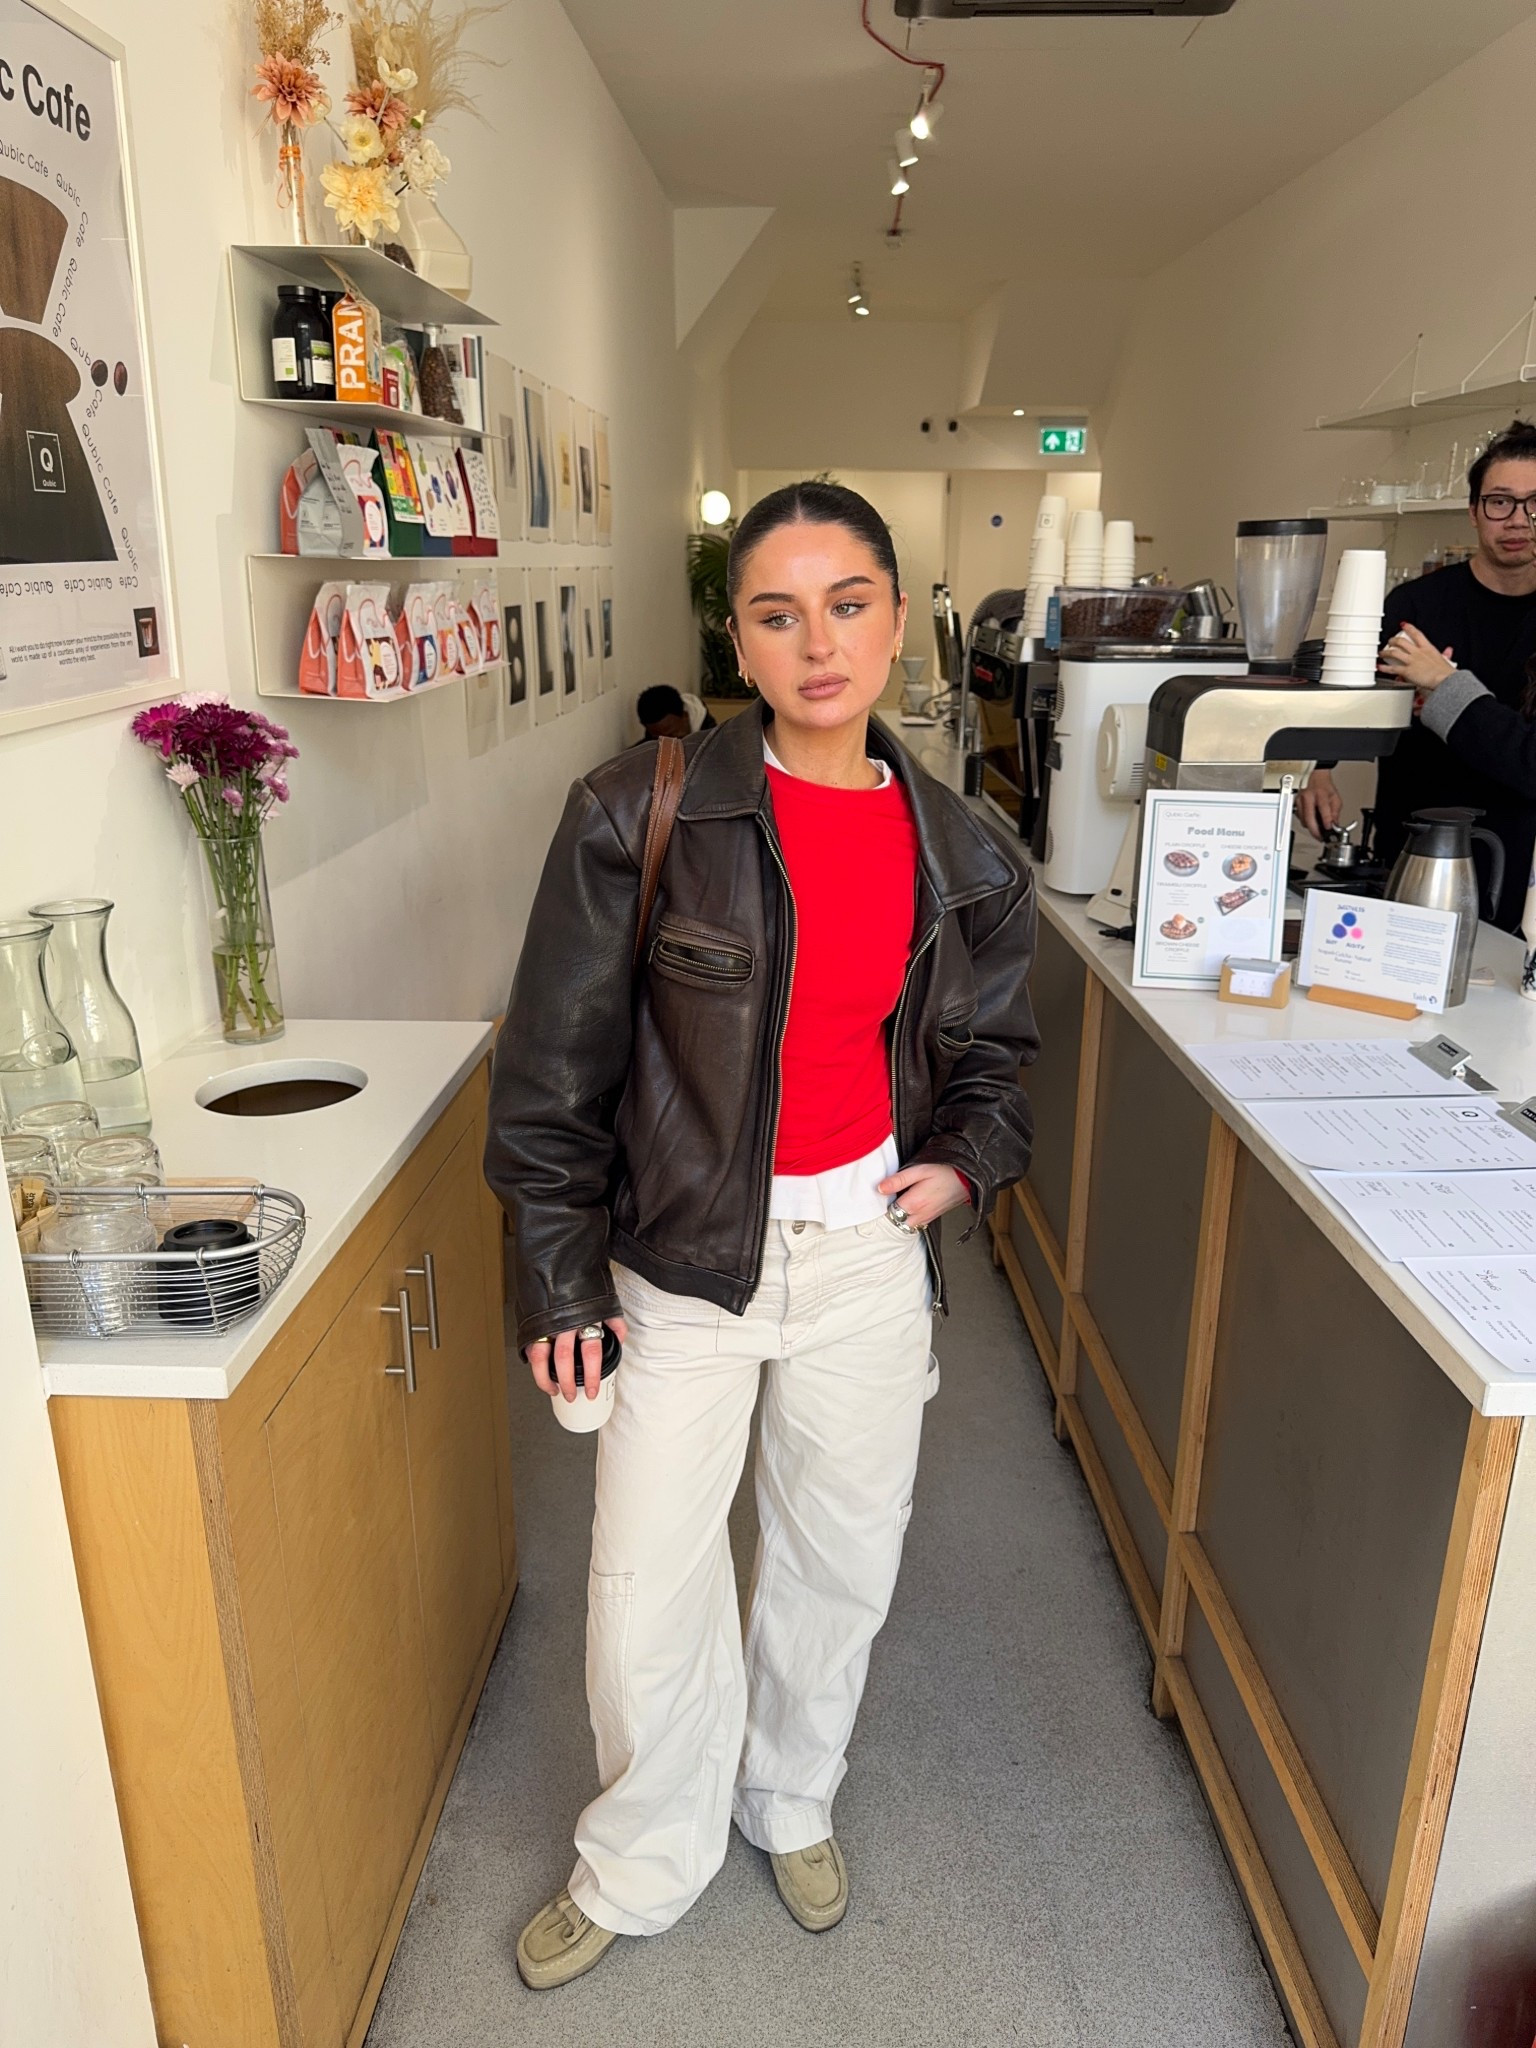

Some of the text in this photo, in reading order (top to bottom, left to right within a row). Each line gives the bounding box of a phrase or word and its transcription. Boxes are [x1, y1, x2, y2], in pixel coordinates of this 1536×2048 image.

[22, 64, 91, 141] Cafe
[27, 154, 49, 178] Cafe
[56, 173, 89, 247] Qubic Cafe
[52, 257, 78, 338] Qubic Cafe
[70, 337, 103, 418] Qub Cafe
[40, 447, 54, 473] Q
[82, 423, 119, 515] Qubic Cafe
[25, 580, 54, 595] Qubic
[64, 577, 113, 593] Qubic Cafe
[119, 527, 139, 589] Qubic Cafe
[1187, 826, 1246, 837] Food Menu
